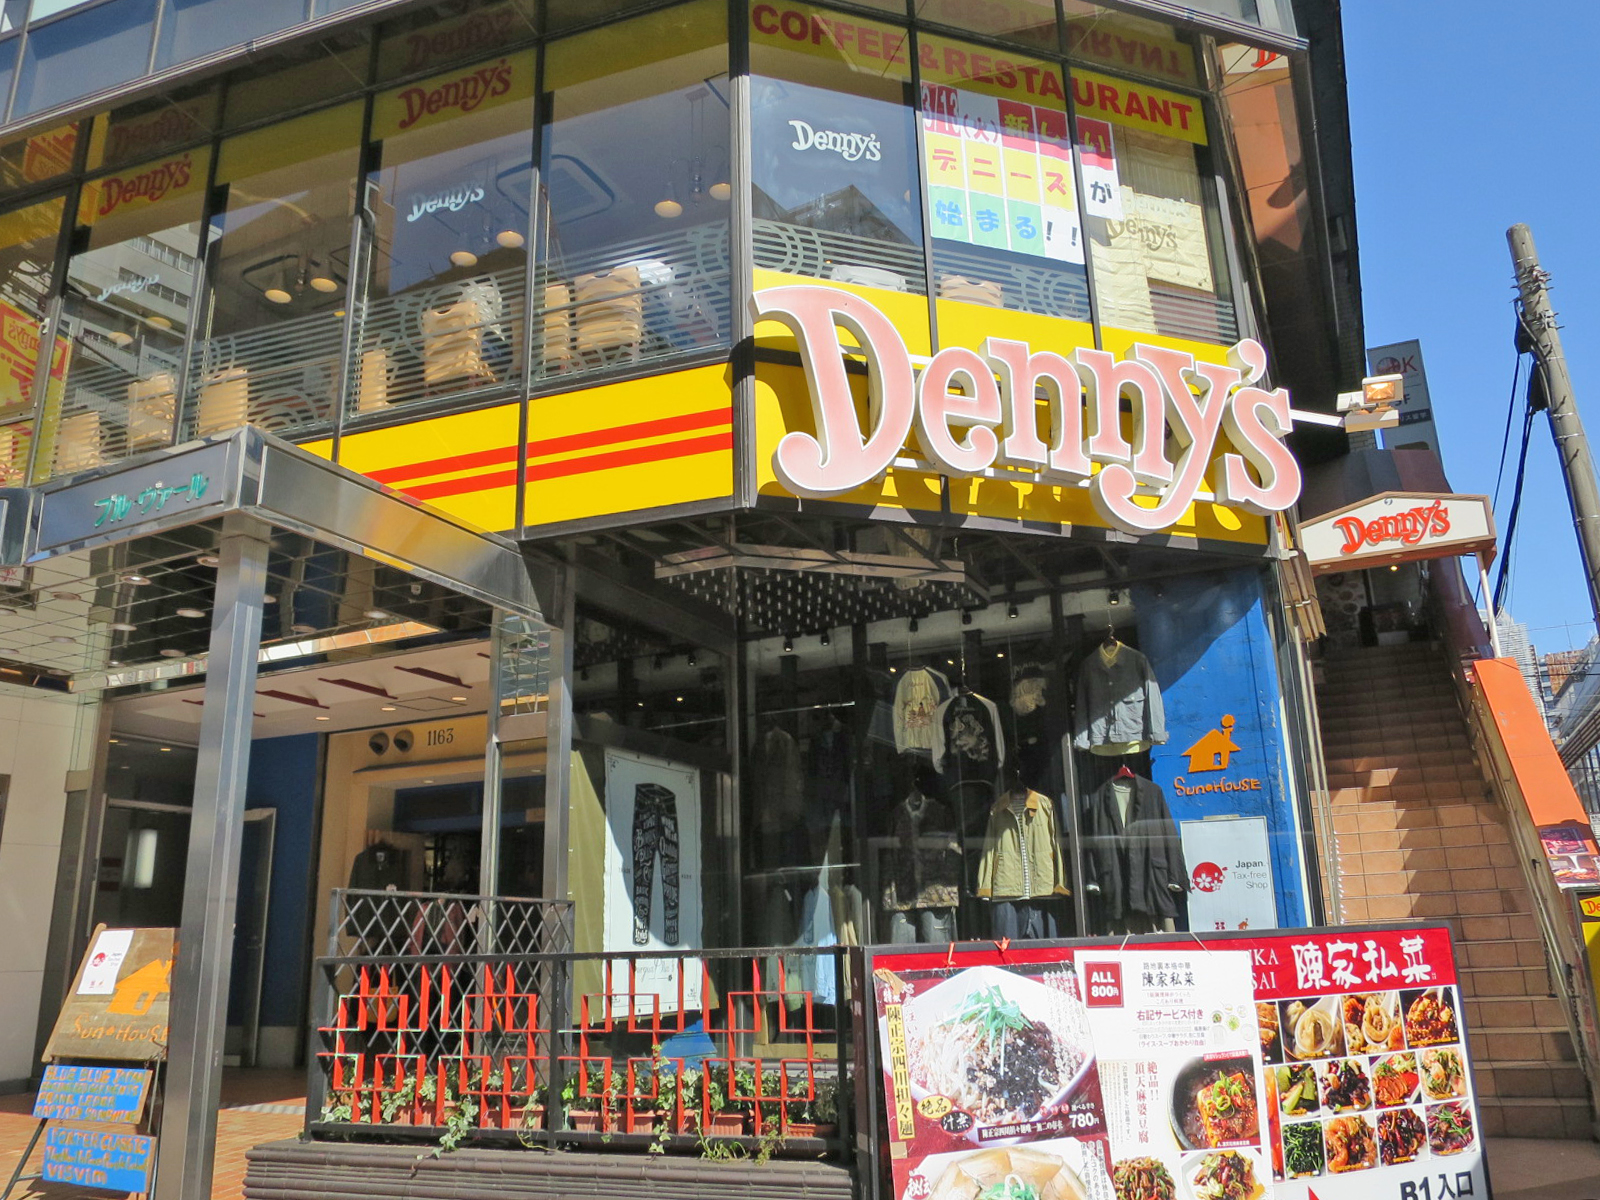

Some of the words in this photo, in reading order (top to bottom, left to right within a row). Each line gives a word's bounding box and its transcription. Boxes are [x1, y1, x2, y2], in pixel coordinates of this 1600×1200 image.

[752, 4, 906, 65] COFFEE
[398, 58, 512, 130] Denny's
[788, 119, 882, 162] Denny's
[99, 152, 192, 216] Denny's
[750, 284, 1303, 536] Denny's
[1333, 499, 1451, 557] Denny's
[427, 727, 454, 746] 1163
[1232, 871, 1267, 880] Tax-free
[1245, 881, 1268, 890] Shop
[1091, 971, 1115, 983] ALL
[1291, 935, 1432, 990] 陳家私菜
[1091, 985, 1119, 997] 800円
[1142, 971, 1195, 987] 陳家私菜
[1136, 1009, 1204, 1021] 右記サービス付き
